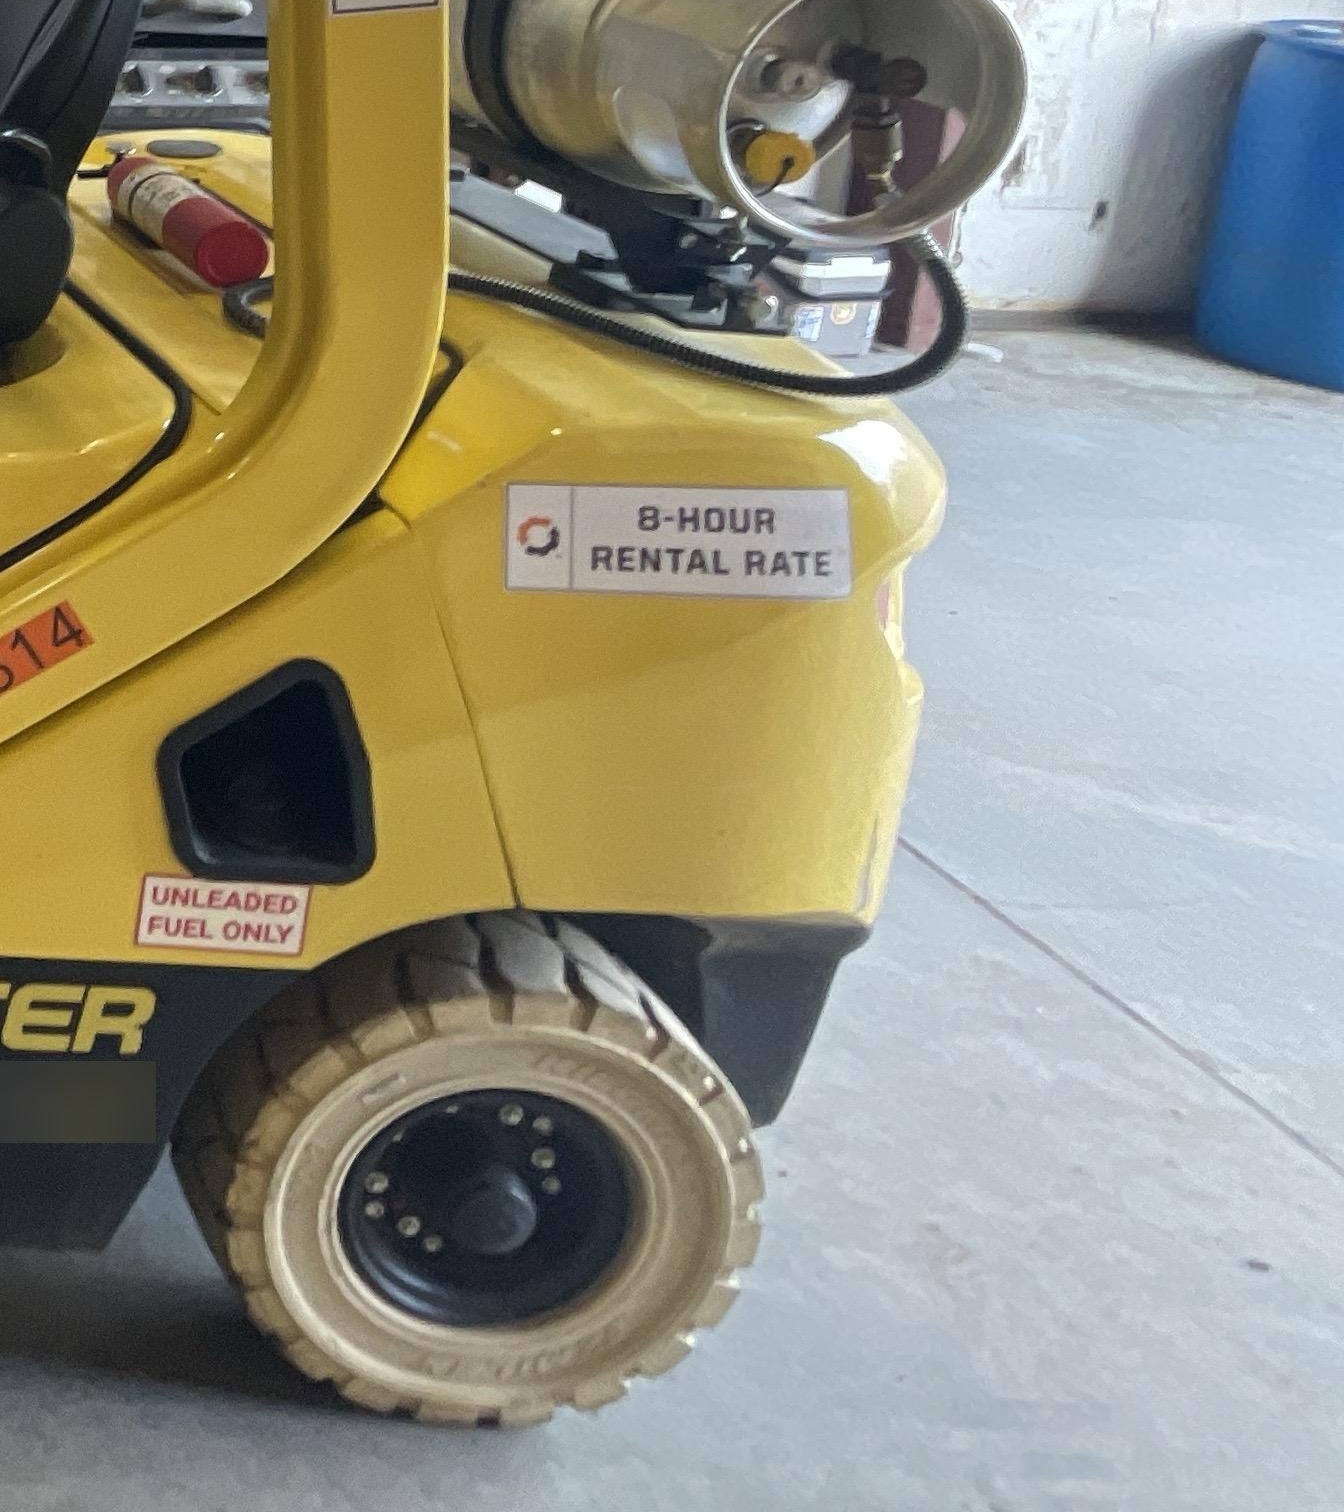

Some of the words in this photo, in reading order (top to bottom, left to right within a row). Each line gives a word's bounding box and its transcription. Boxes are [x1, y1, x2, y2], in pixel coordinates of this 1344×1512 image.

[637, 505, 776, 534] 8-HOUR
[590, 545, 730, 576] RENTAL
[744, 550, 831, 577] RATE
[151, 885, 299, 915] UNLEADED
[146, 917, 214, 942] FUEL
[223, 920, 295, 946] ONLY
